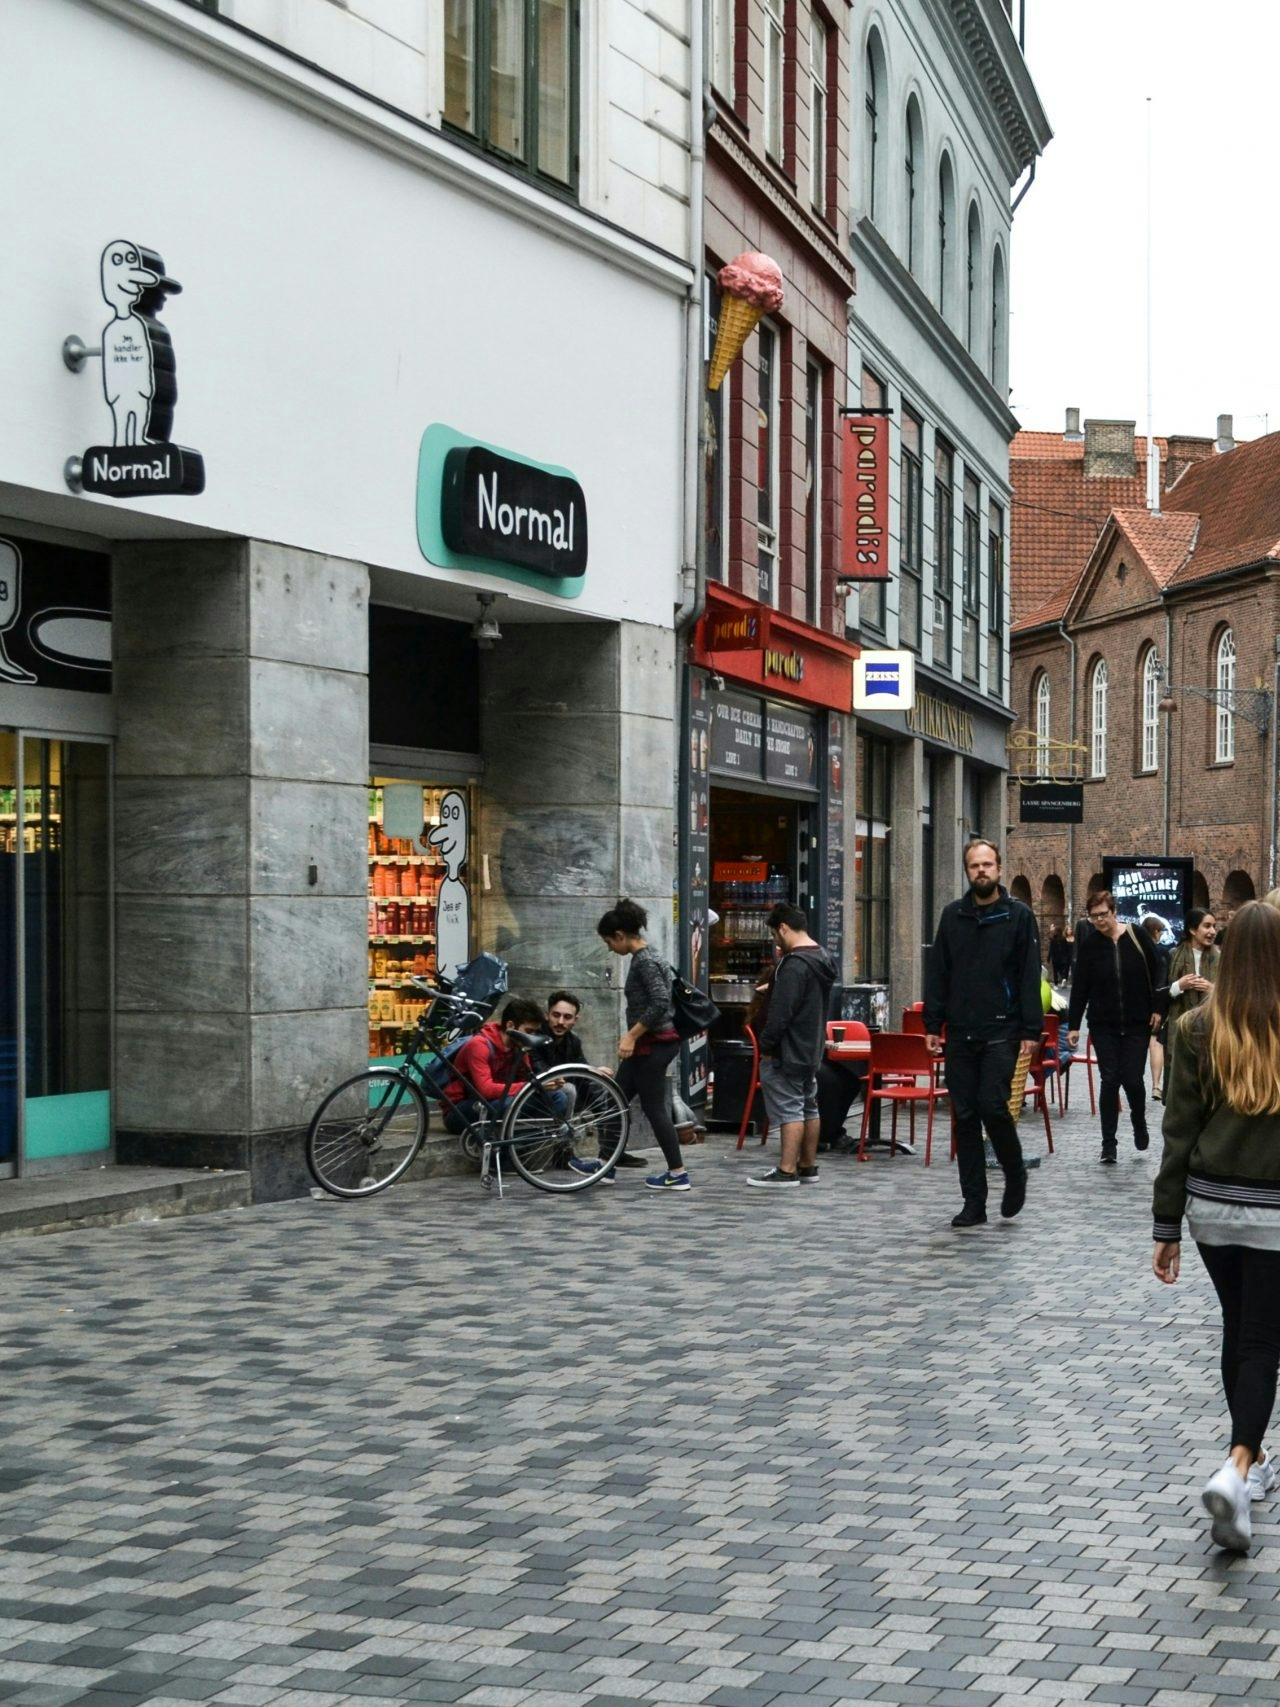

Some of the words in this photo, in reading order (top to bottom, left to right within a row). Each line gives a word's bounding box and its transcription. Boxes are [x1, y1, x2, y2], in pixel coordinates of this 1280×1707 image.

[113, 343, 142, 352] handler
[113, 353, 128, 363] ikke
[130, 354, 144, 363] her
[92, 453, 171, 483] Normal
[850, 424, 883, 565] paradis
[478, 470, 574, 551] Normal
[865, 671, 899, 681] ZEISS
[716, 703, 729, 720] OUR
[735, 728, 753, 746] DAILY
[1118, 871, 1145, 886] PAUL
